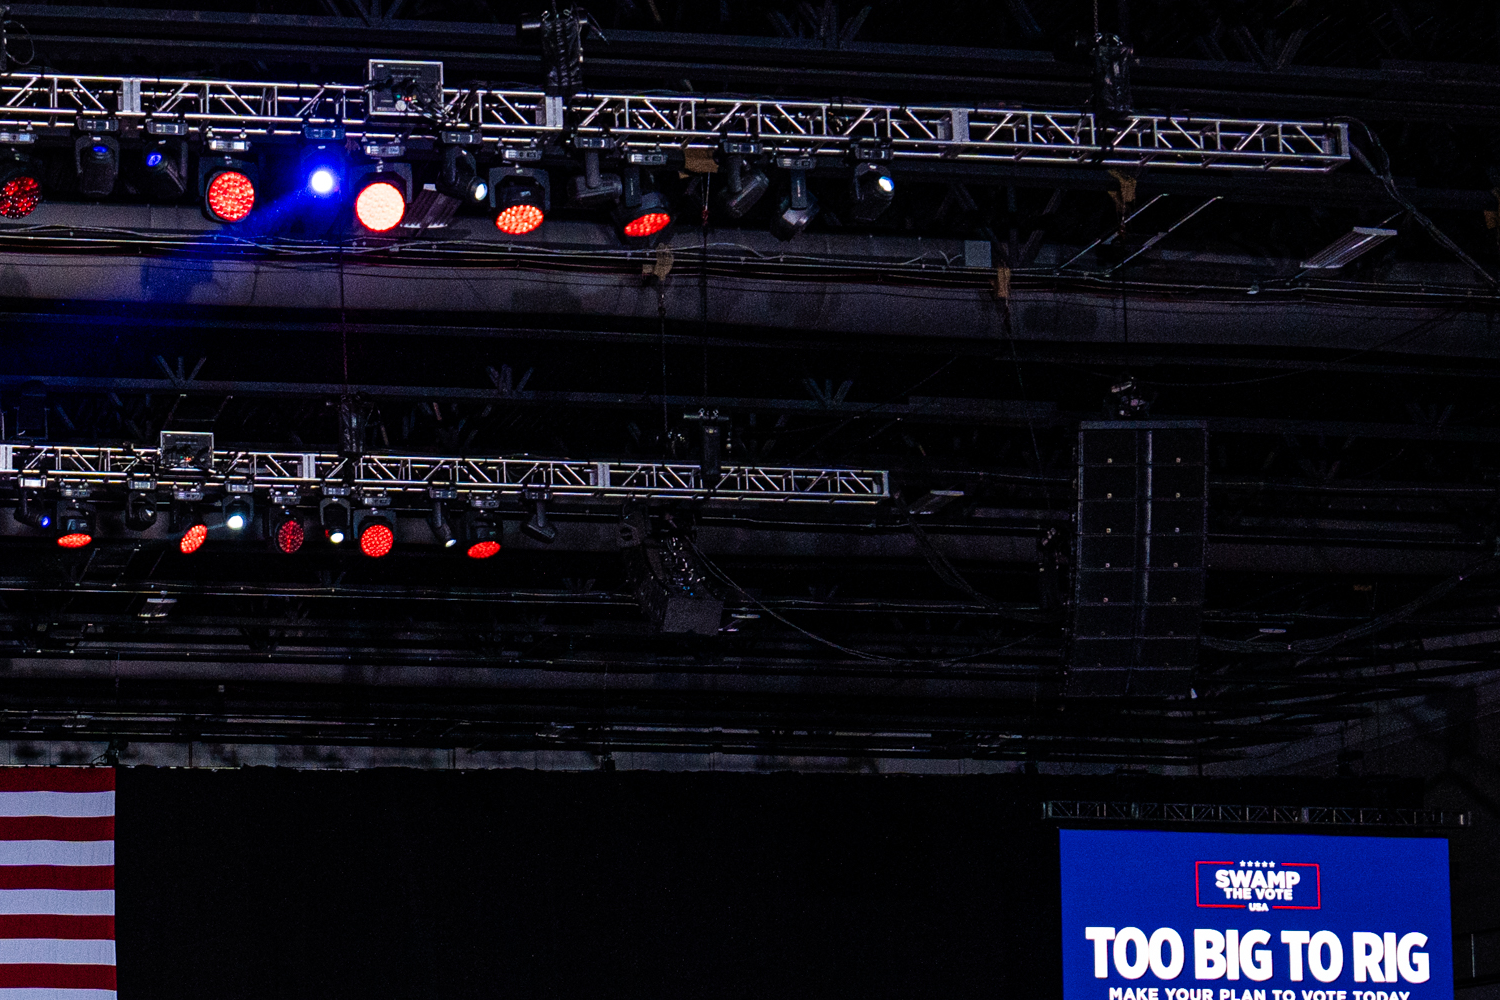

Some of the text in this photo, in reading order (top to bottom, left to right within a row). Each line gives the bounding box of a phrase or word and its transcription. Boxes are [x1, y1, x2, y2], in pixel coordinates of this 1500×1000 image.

[1215, 869, 1300, 889] SWAMP
[1224, 888, 1293, 901] THE VOTE
[1249, 903, 1269, 912] USA
[1085, 926, 1431, 984] TOO BIG TO RIG
